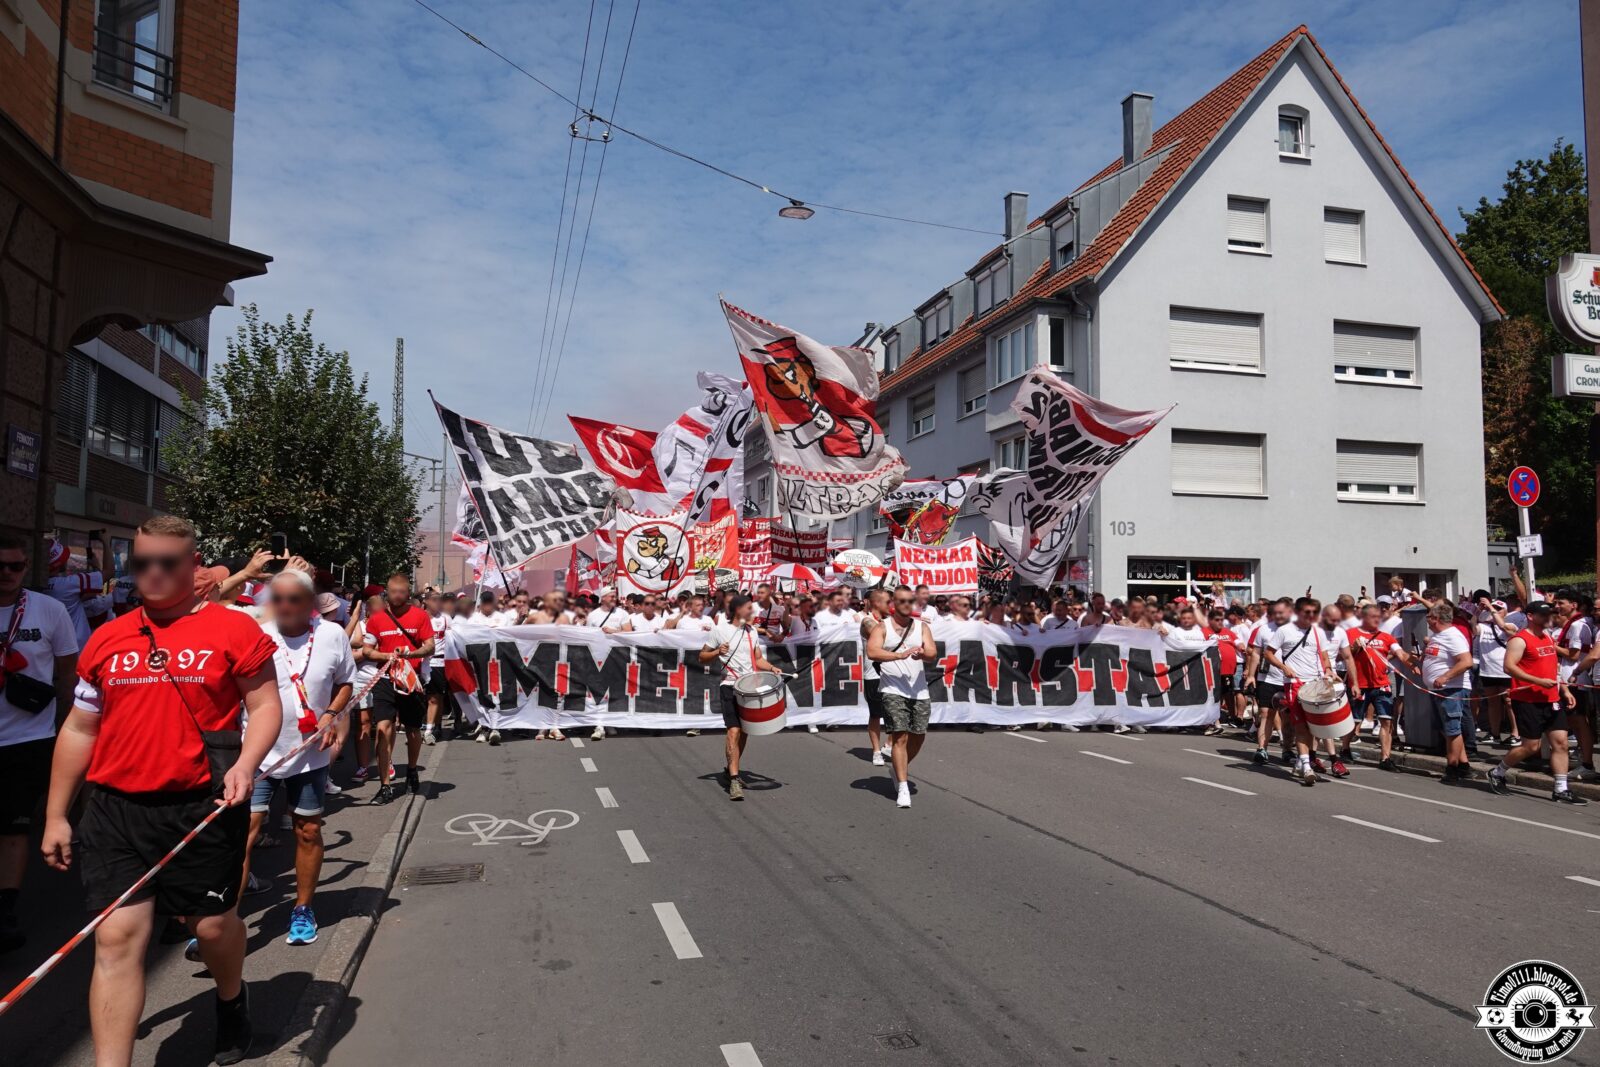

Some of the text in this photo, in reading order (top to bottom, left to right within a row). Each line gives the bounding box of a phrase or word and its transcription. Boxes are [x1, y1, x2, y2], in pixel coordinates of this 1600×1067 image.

[1109, 521, 1136, 536] 103
[900, 545, 974, 564] NECKAR
[900, 566, 978, 586] STADION
[108, 673, 205, 686] Commando Cnnstatt
[465, 641, 724, 714] IMMER
